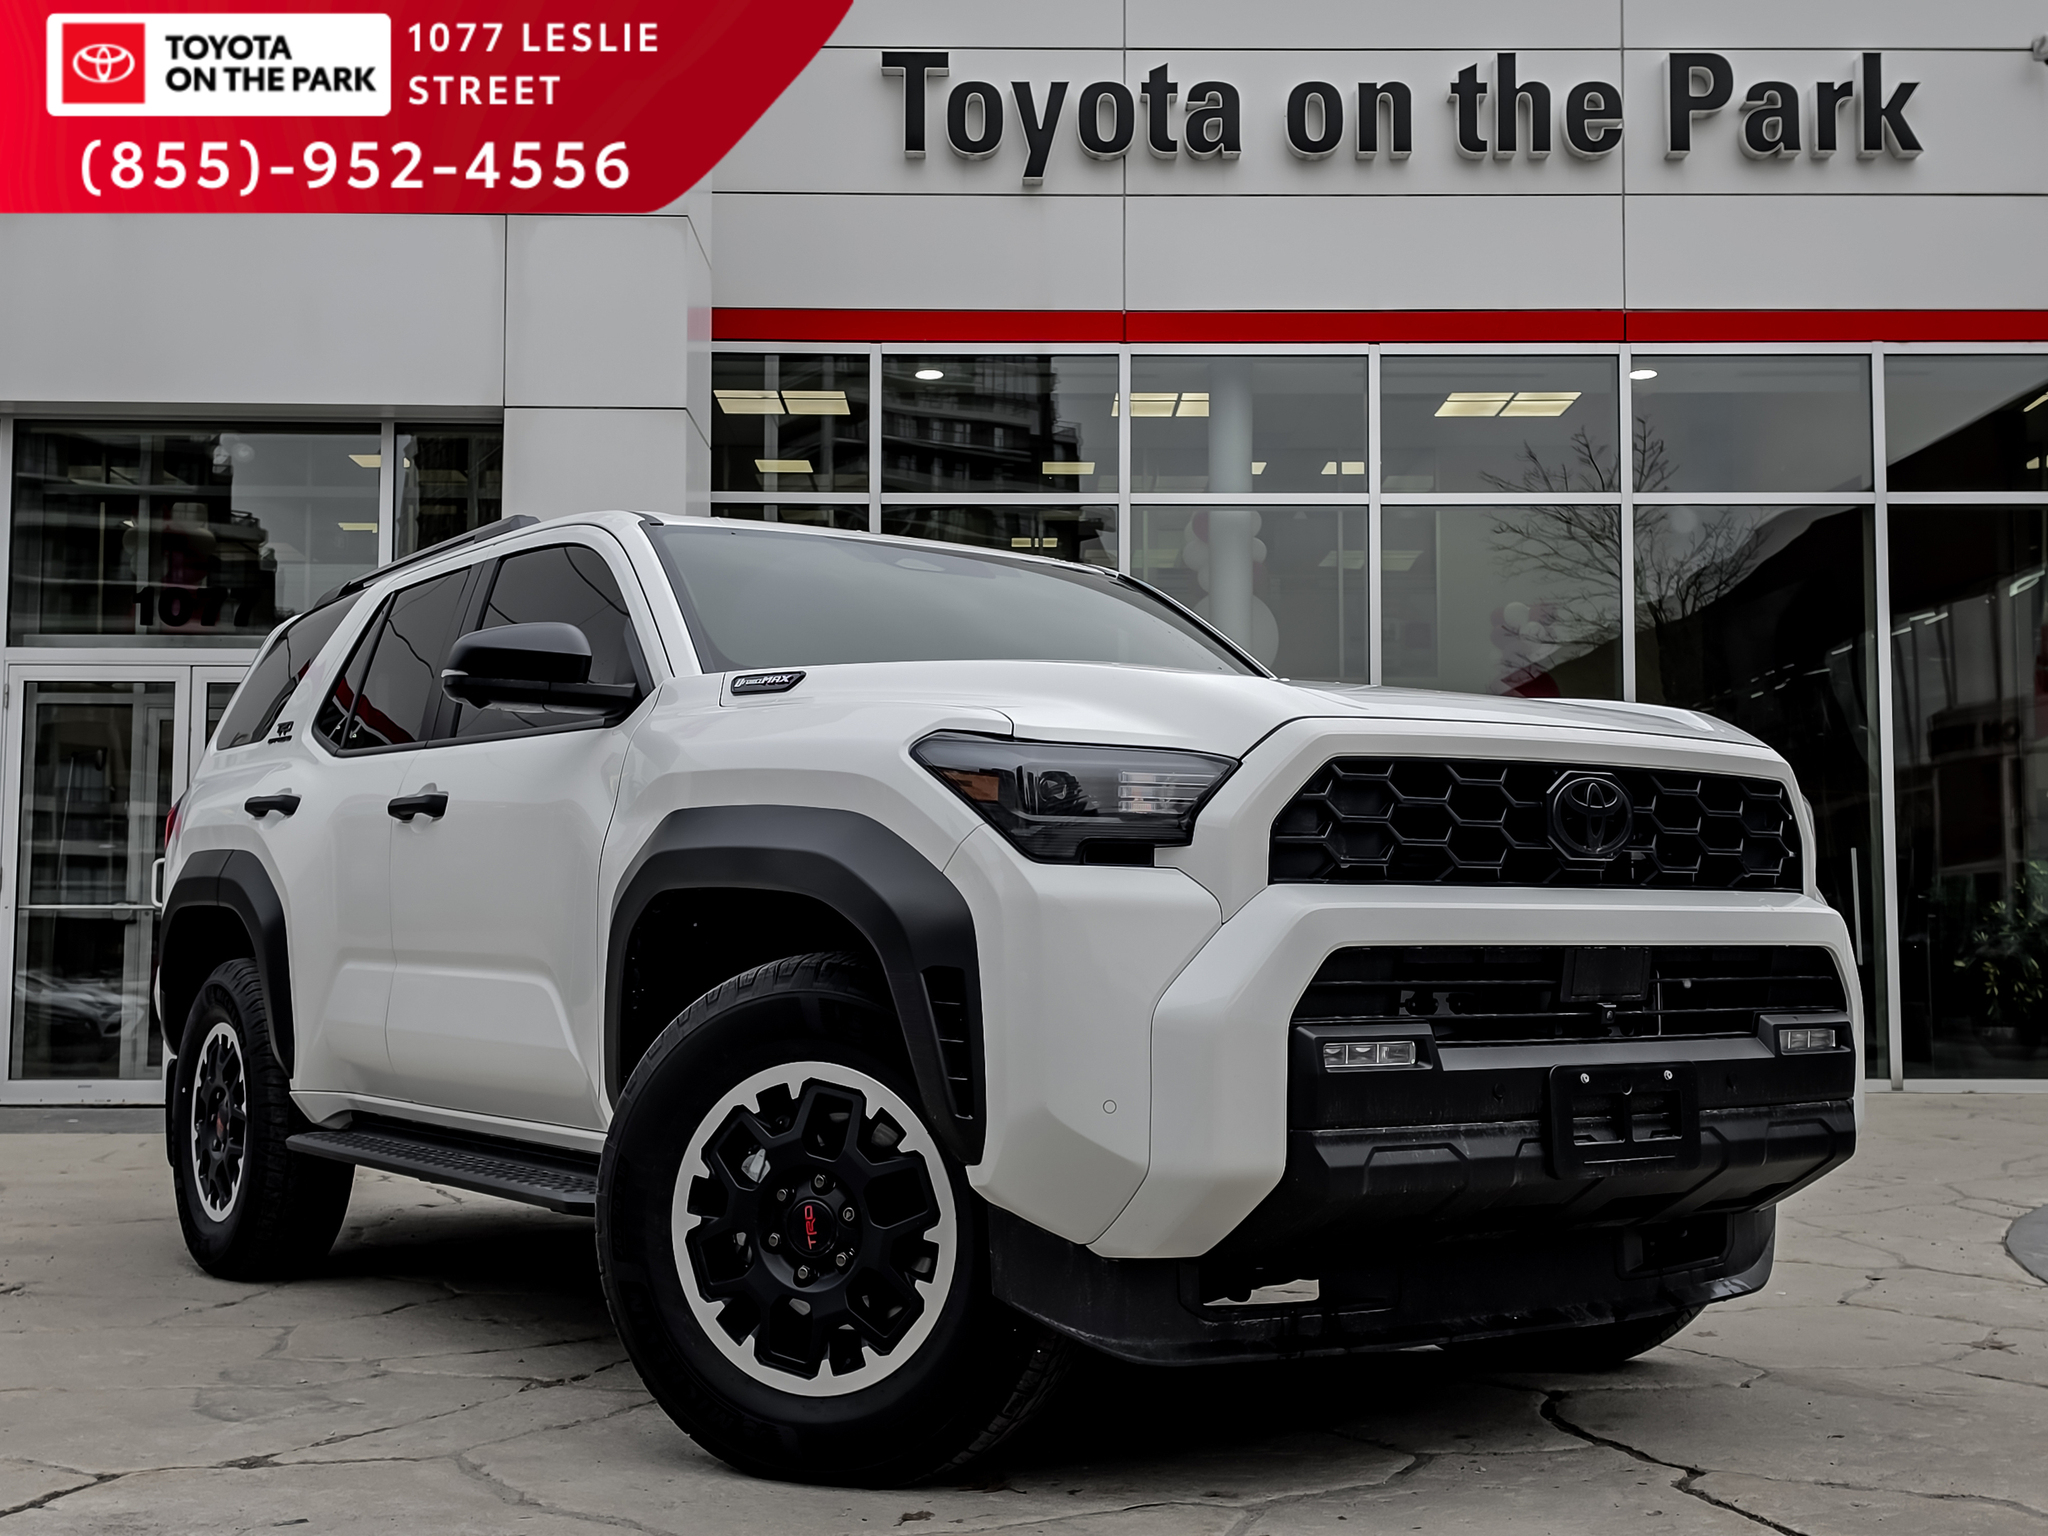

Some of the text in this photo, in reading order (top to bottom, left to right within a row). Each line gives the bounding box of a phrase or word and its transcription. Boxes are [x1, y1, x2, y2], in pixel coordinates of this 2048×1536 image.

[881, 51, 1923, 185] Toyota on the Park
[133, 586, 261, 627] 1077
[804, 1205, 817, 1250] TRD
